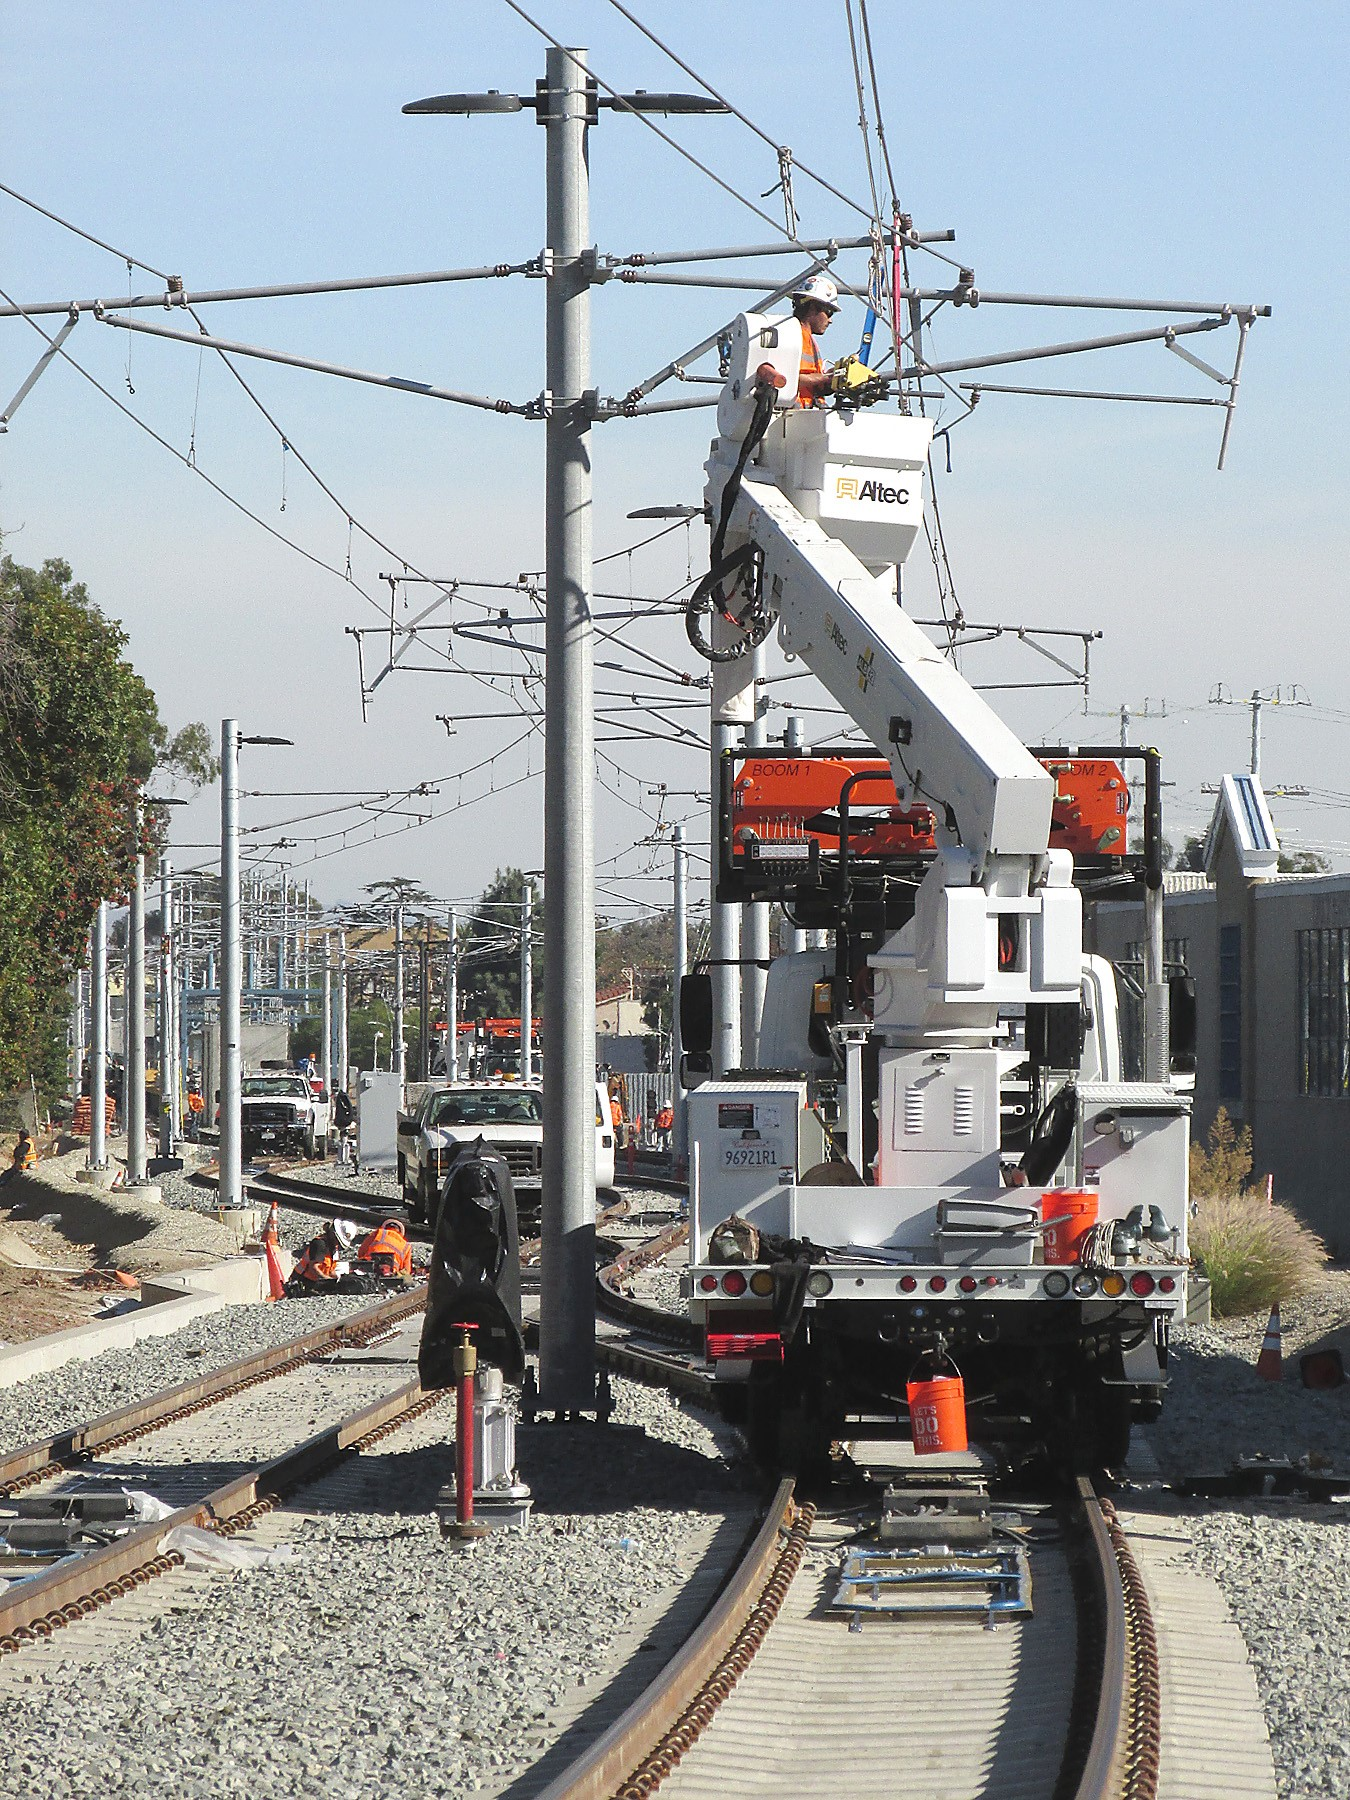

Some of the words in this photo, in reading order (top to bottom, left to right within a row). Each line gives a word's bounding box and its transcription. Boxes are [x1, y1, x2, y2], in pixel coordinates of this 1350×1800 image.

[859, 481, 909, 504] Altec
[753, 764, 799, 776] BOOM
[805, 765, 810, 776] 1
[1060, 764, 1095, 776] OM
[1098, 764, 1108, 776] 2
[725, 1150, 777, 1165] 96921R1
[915, 1416, 939, 1434] DO
[917, 1435, 943, 1446] THIS.
